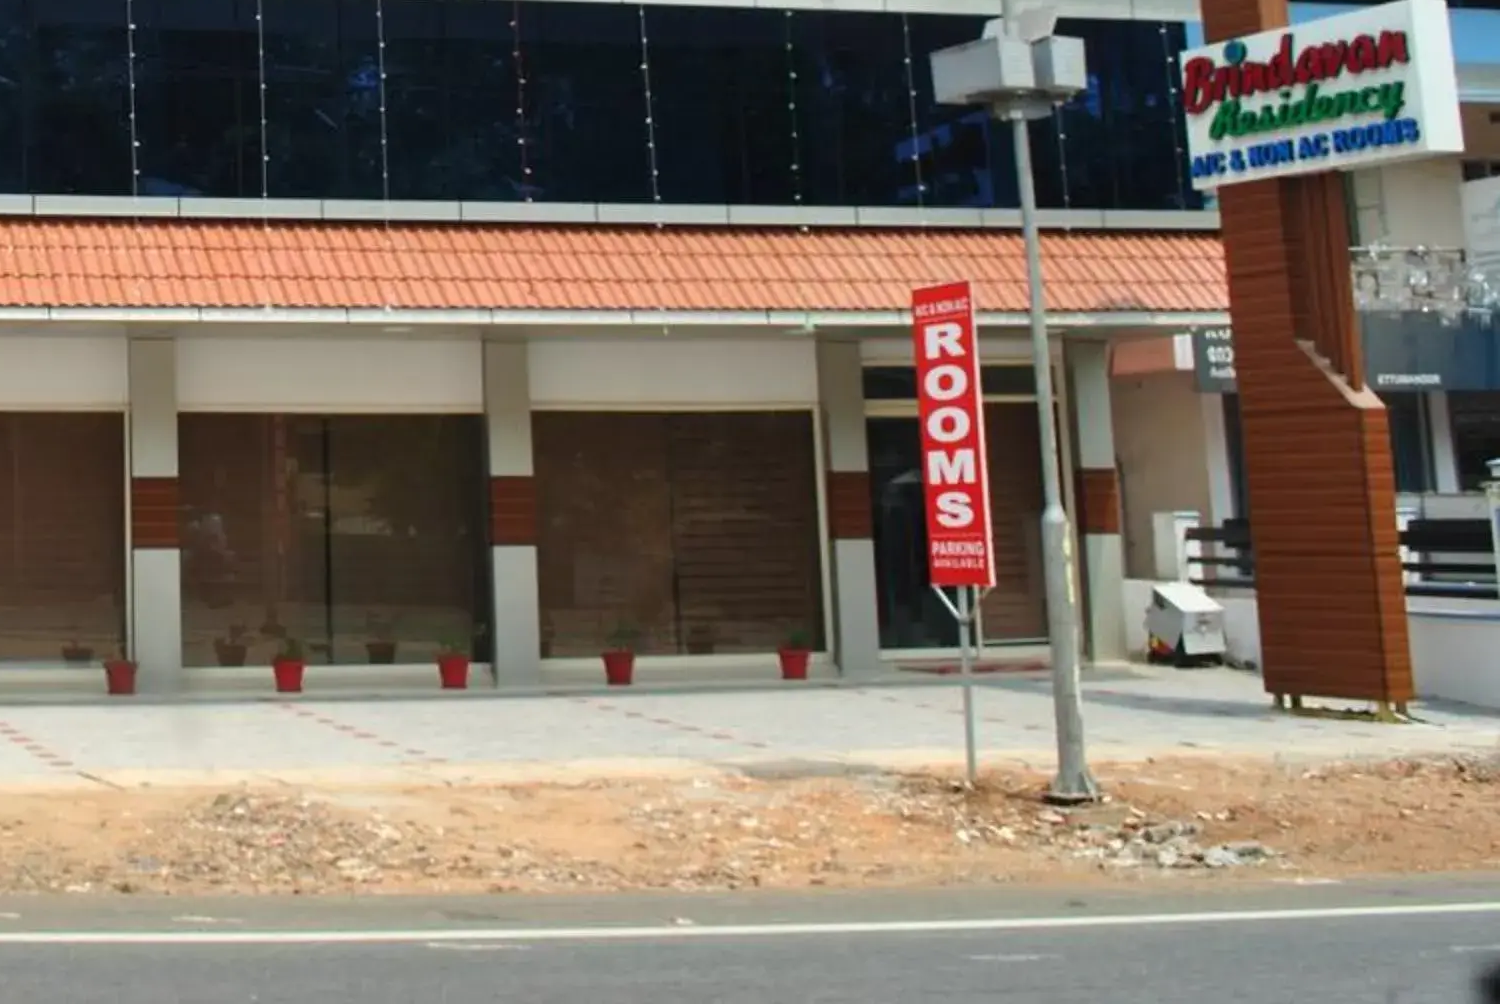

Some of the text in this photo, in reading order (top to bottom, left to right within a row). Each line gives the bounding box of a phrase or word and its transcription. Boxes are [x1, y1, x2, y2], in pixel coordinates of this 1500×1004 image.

[1184, 30, 1410, 115] Brindavan
[1209, 81, 1406, 140] Residency
[1229, 149, 1246, 173] &
[1247, 139, 1295, 168] NON
[1332, 117, 1421, 153] ROOMS
[923, 322, 977, 528] ROOMS
[931, 540, 985, 555] PARKING
